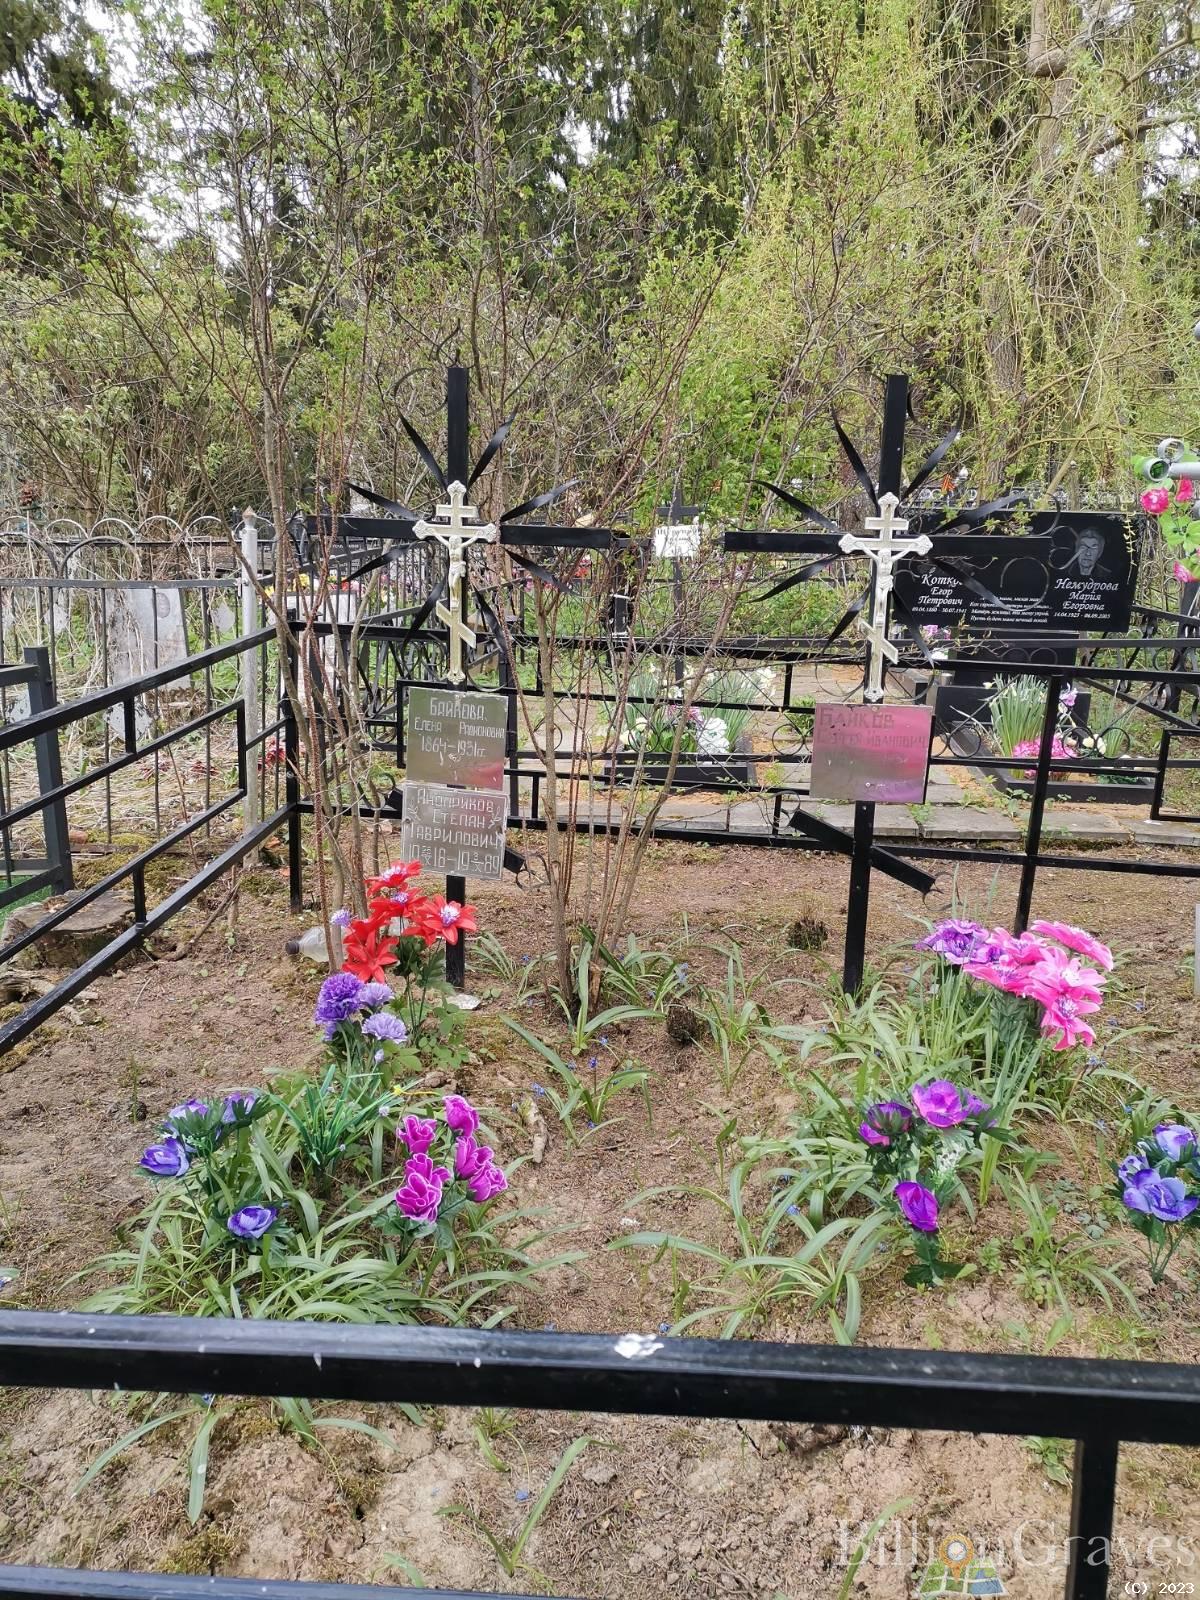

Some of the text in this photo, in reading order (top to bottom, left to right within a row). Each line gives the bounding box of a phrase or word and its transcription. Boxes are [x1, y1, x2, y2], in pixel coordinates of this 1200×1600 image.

[1054, 577, 1119, 593] Немудрова
[931, 586, 953, 598] Егор
[1068, 590, 1102, 603] Мария
[918, 595, 963, 607] Петрович
[1062, 601, 1105, 612] Егоровна
[432, 808, 485, 829] СТЕПАН
